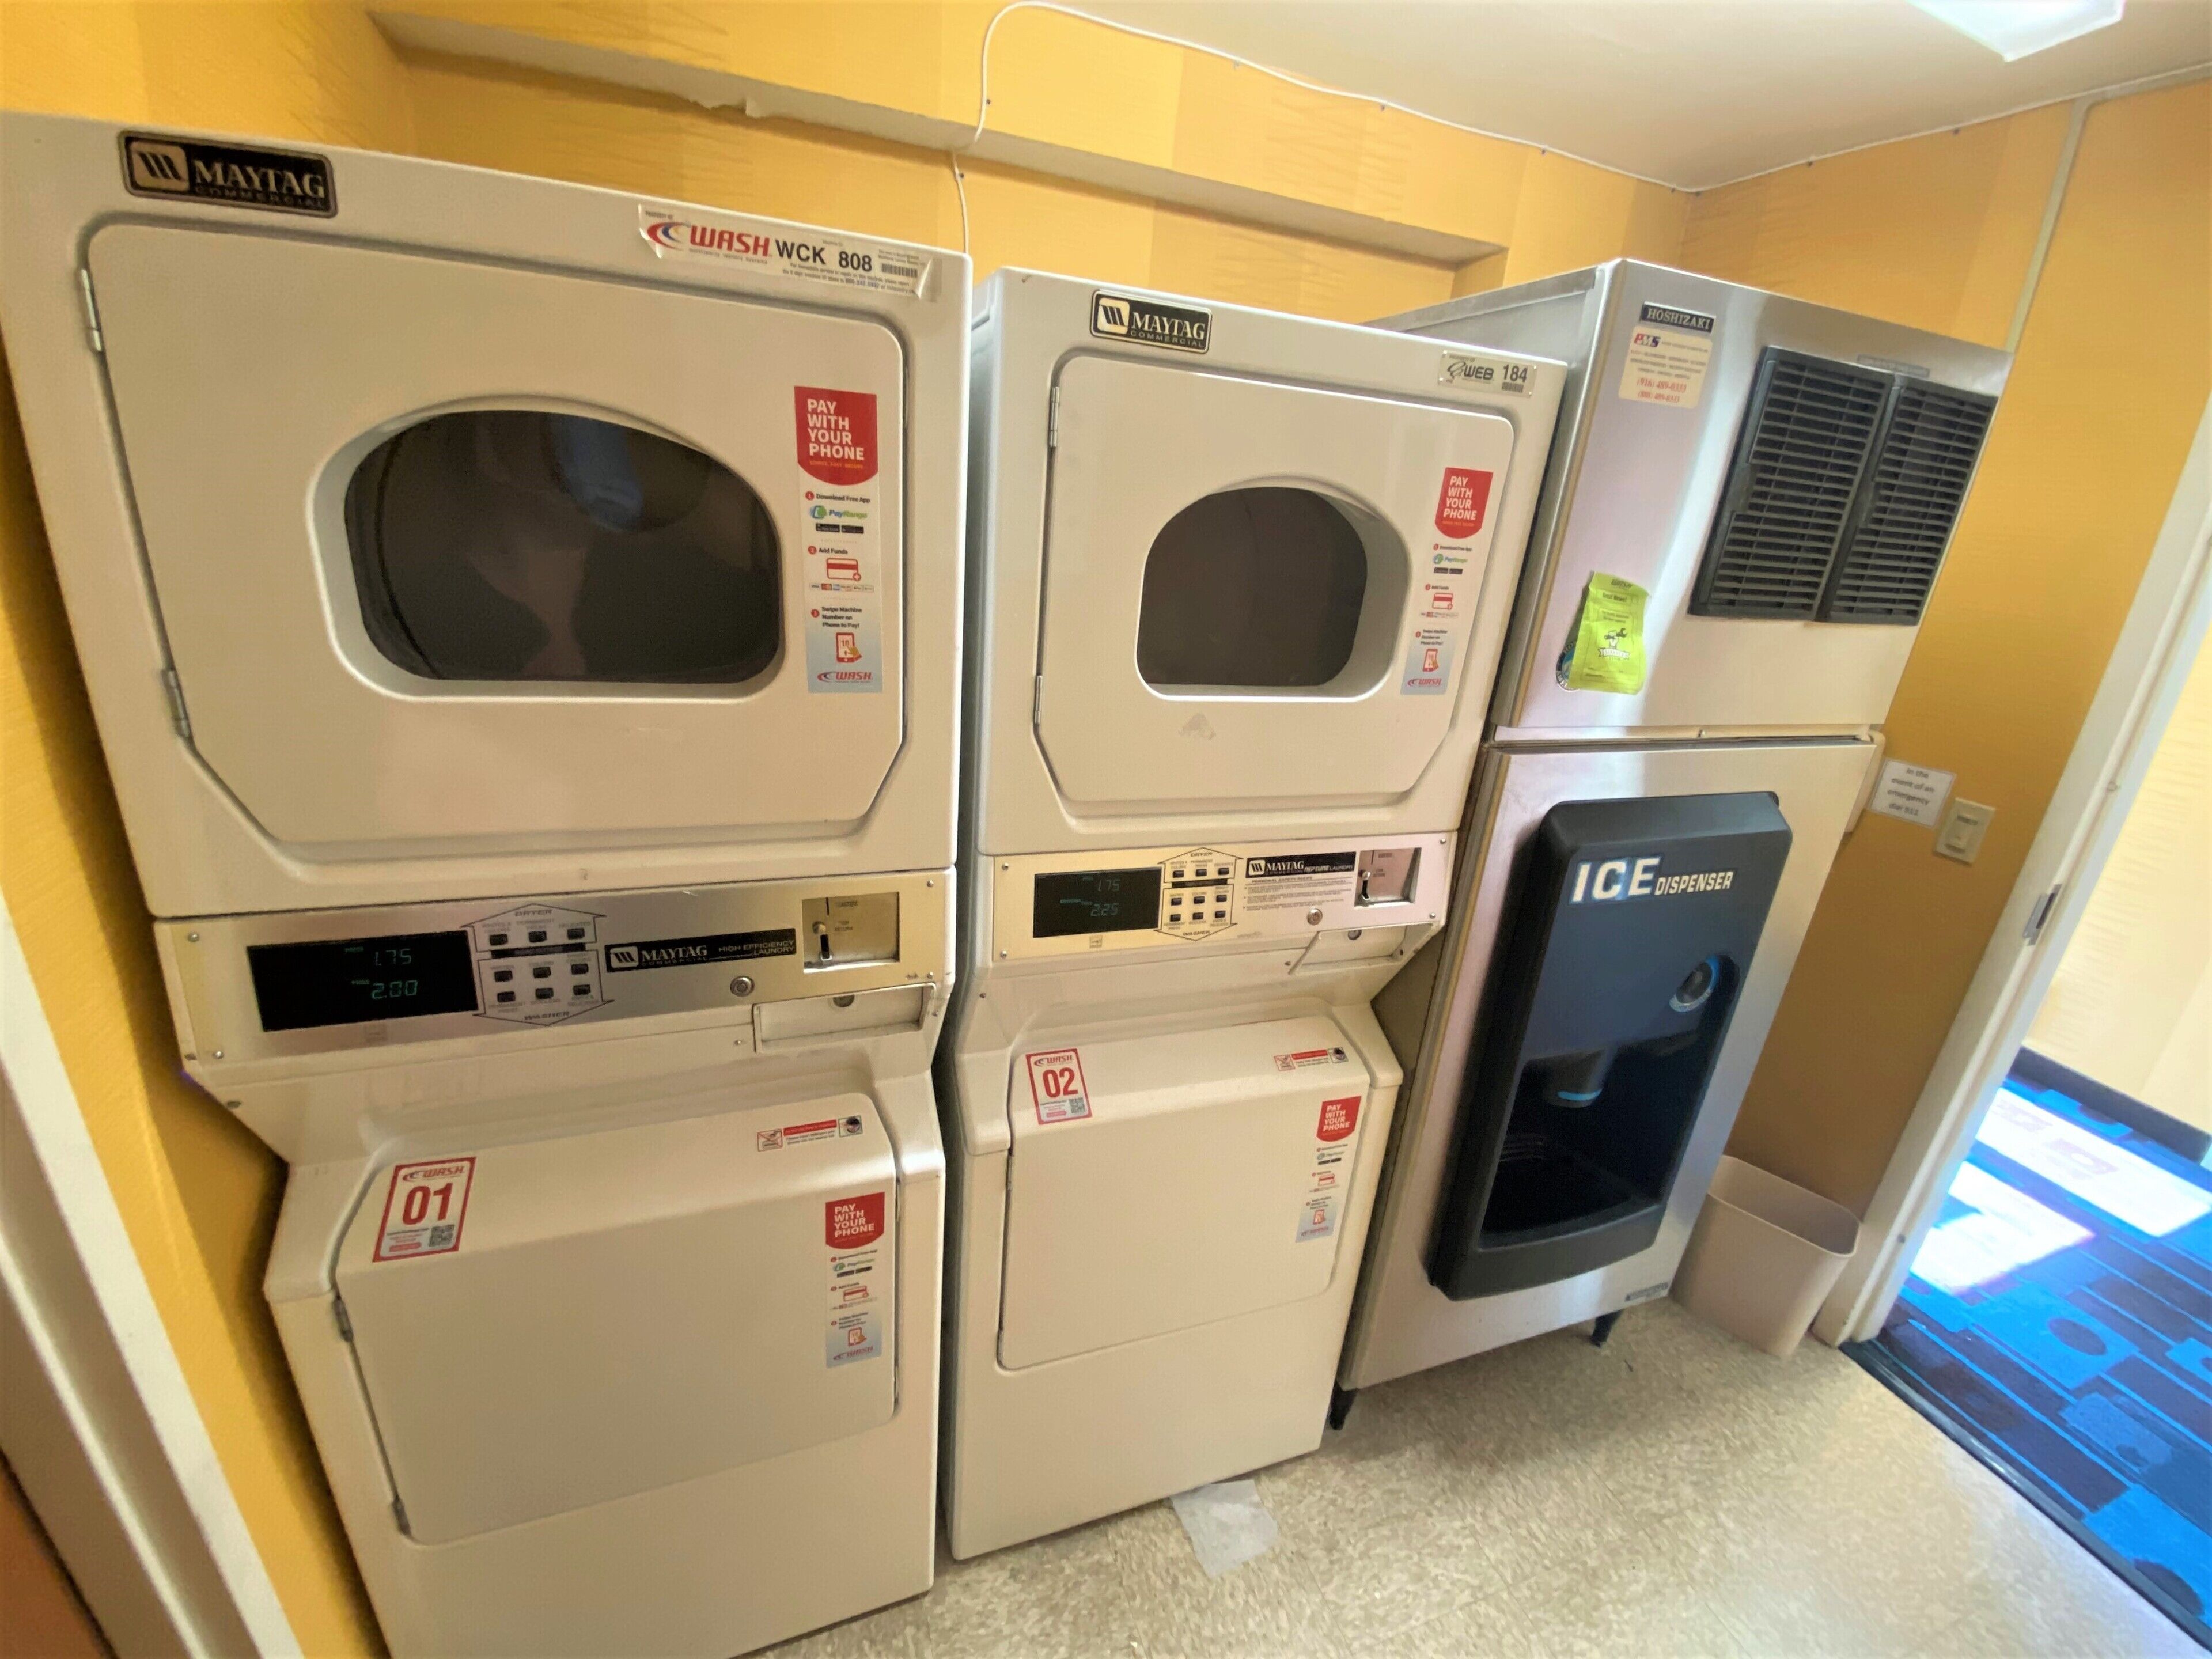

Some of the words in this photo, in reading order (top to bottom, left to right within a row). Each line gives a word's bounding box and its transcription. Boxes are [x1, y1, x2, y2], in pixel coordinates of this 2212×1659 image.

[194, 160, 324, 198] MAYTAG
[690, 224, 770, 257] WASH
[775, 238, 827, 266] WCK
[838, 251, 872, 272] 808
[1646, 307, 1711, 331] HOSHIZAKI
[1131, 312, 1206, 340] MAYTAG
[1130, 329, 1203, 347] COMMERCIAL
[1464, 364, 1494, 380] WEB
[1503, 363, 1528, 383] 184
[807, 399, 836, 414] PAY
[807, 414, 850, 430] WITH
[808, 428, 852, 445] YOUR
[809, 443, 865, 461] PHONE
[1450, 475, 1468, 486] PAY
[816, 493, 845, 501] Download
[859, 496, 871, 504] App
[1448, 487, 1473, 498] WITH
[1446, 498, 1472, 509] YOUR
[1444, 508, 1478, 521] PHONE
[835, 671, 872, 681] WASH
[1915, 769, 1929, 779] the
[1891, 778, 1914, 787] event
[1914, 782, 1925, 790] of
[1887, 789, 1930, 806] emergency
[1904, 806, 1919, 816] 911
[1264, 861, 1305, 871] MAYTAG
[1572, 856, 1661, 902] ICE
[1654, 871, 1734, 896] DISPENSER
[514, 909, 553, 917] DRYER
[641, 945, 707, 963] MAYTAG
[718, 945, 741, 953] HIGH
[743, 940, 794, 951] EFFICIENCY
[753, 946, 794, 956] LAUNDRY
[372, 980, 419, 999] 2.00
[524, 1010, 570, 1021] WASHER
[1047, 1055, 1073, 1063] WASH
[1043, 1067, 1078, 1099] 02
[1325, 1109, 1346, 1119] WITH
[1327, 1104, 1342, 1112] PAY
[1323, 1121, 1350, 1132] PHONE
[1324, 1116, 1346, 1126] YOUR
[422, 1165, 464, 1179] WASH
[402, 1182, 453, 1225] 01
[834, 1203, 856, 1214] PAY
[834, 1210, 865, 1222] WITH
[834, 1217, 866, 1230] YOUR
[834, 1223, 874, 1238] PHONE
